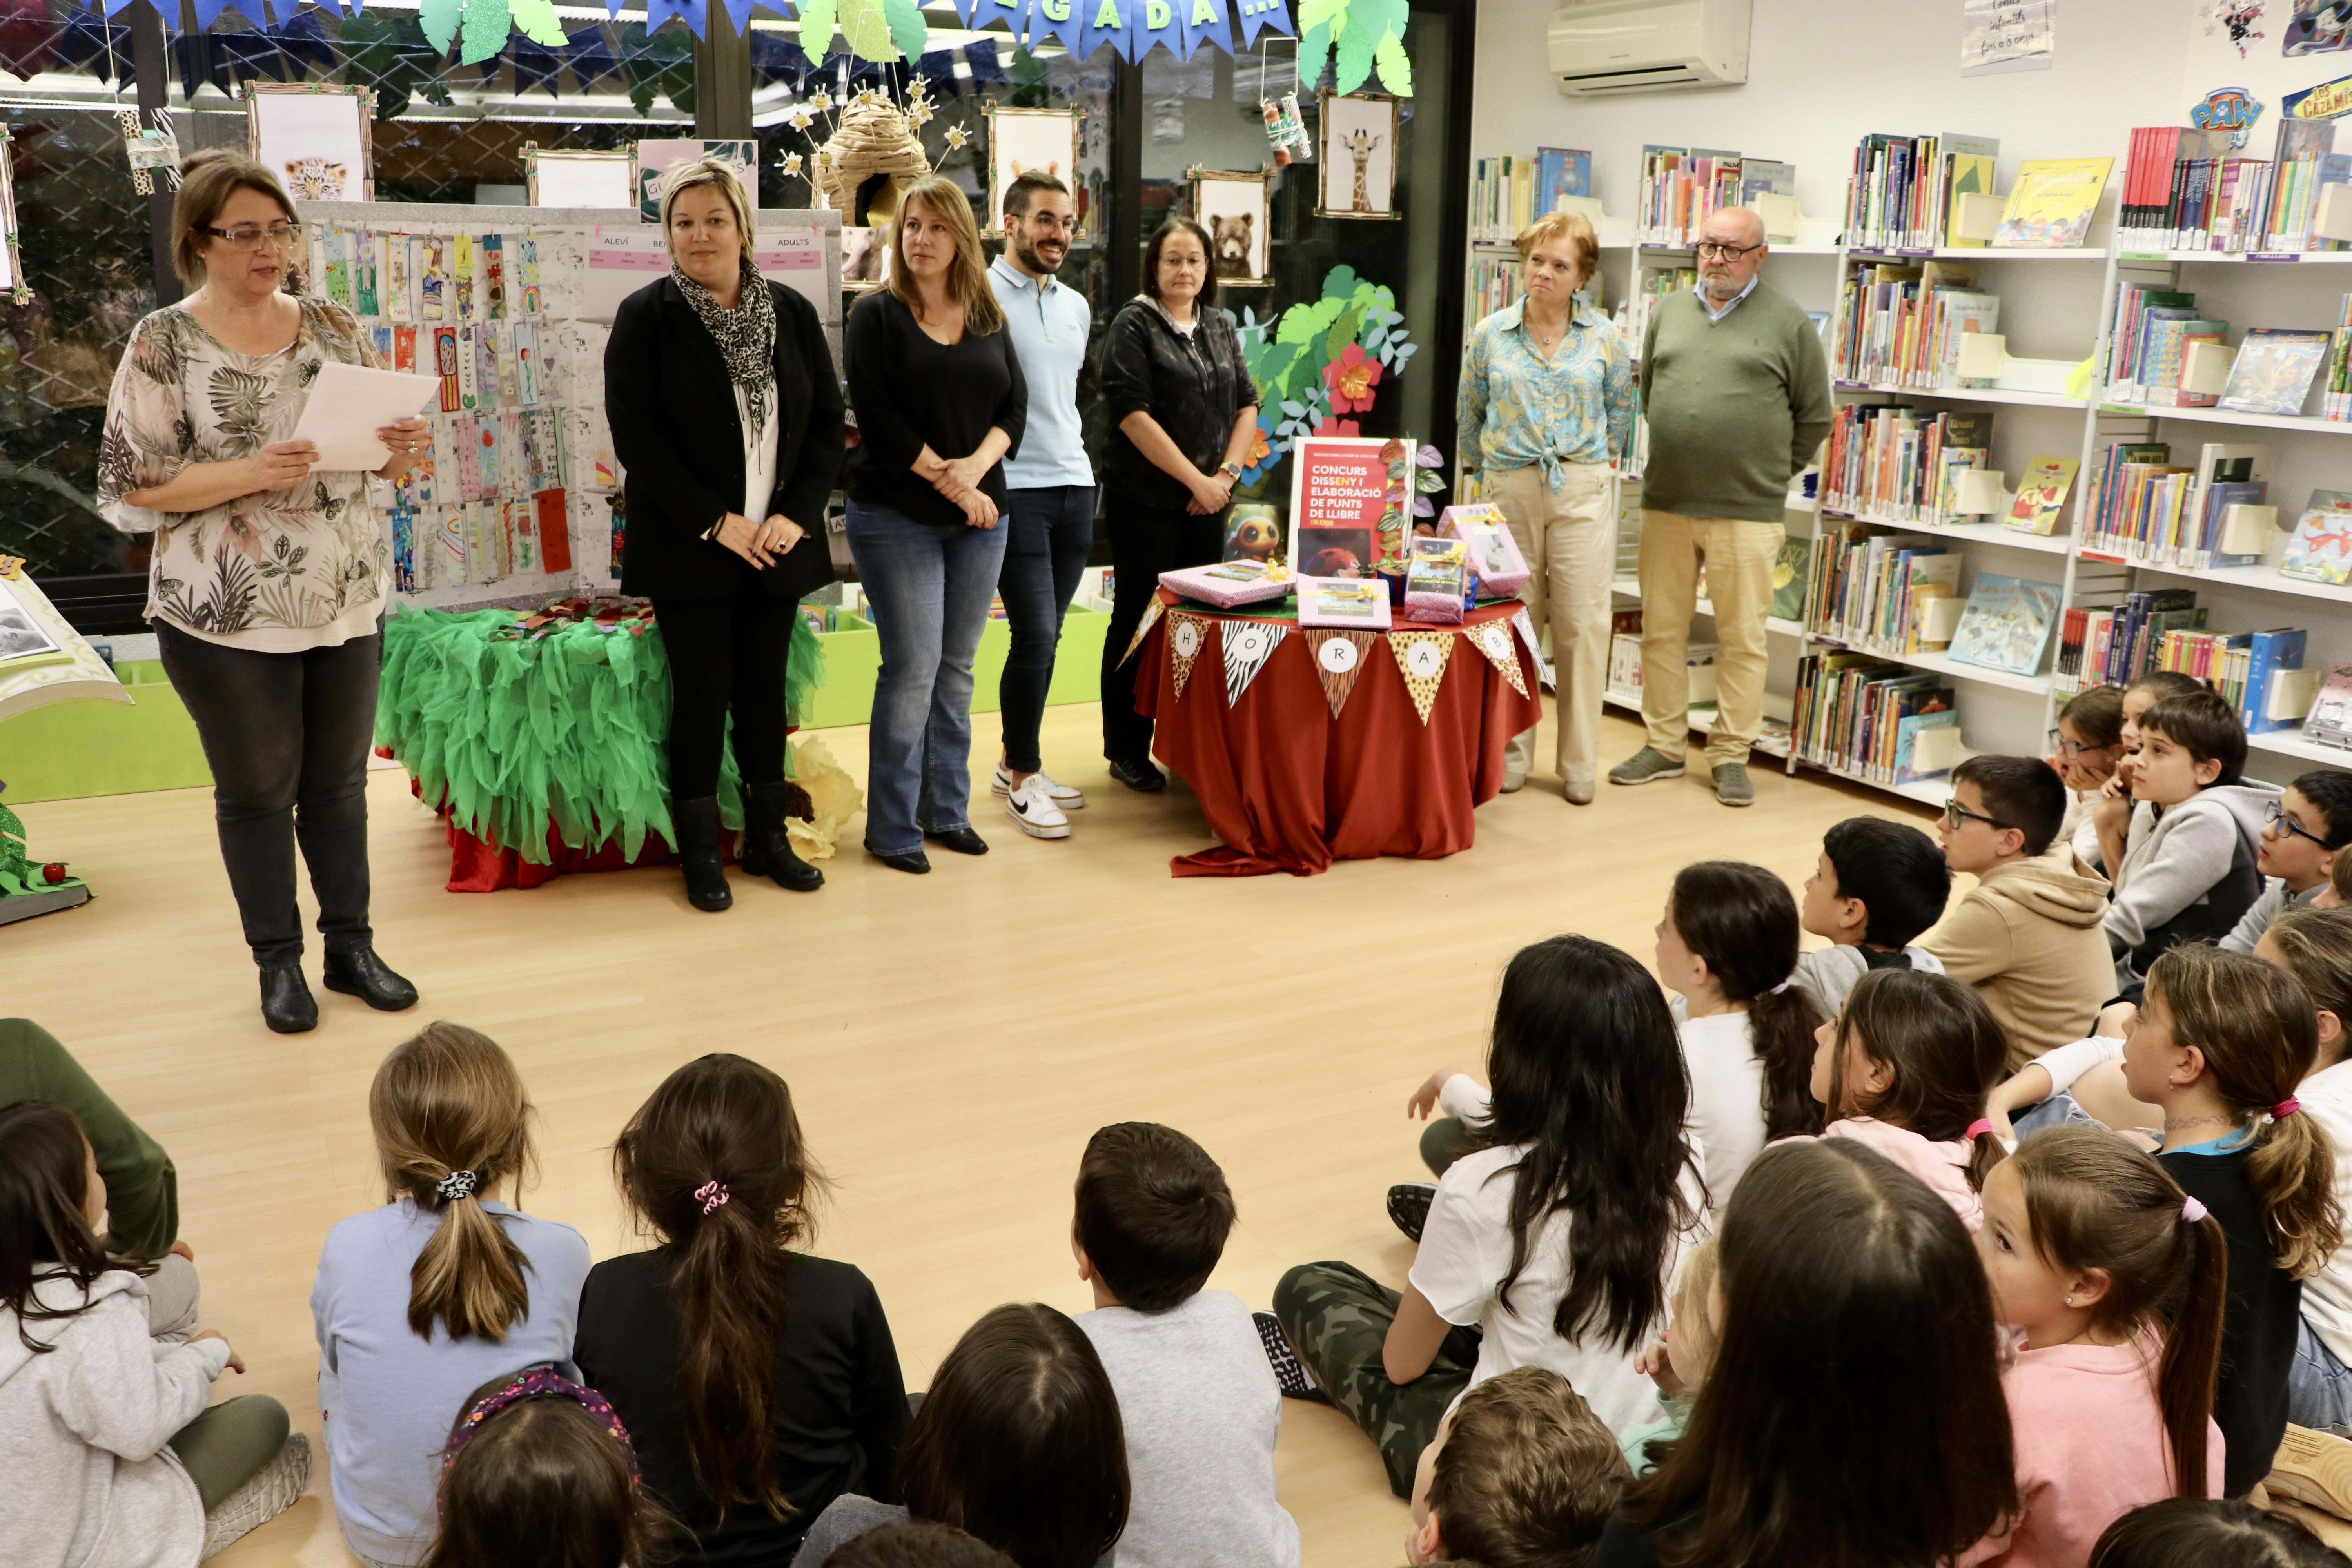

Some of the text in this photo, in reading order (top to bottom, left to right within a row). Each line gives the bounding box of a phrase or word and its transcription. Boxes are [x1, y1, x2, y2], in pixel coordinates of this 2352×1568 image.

[2191, 98, 2264, 129] PAW
[2033, 172, 2091, 183] REGARDE
[604, 237, 629, 245] ALEVÍ
[1312, 465, 1367, 476] CONCURS
[1312, 476, 1363, 486] DISSENY I
[1311, 487, 1382, 498] ELABORACIÓ
[1310, 498, 1363, 508] DE PUNTS
[1310, 509, 1361, 519] DE LLIBRE
